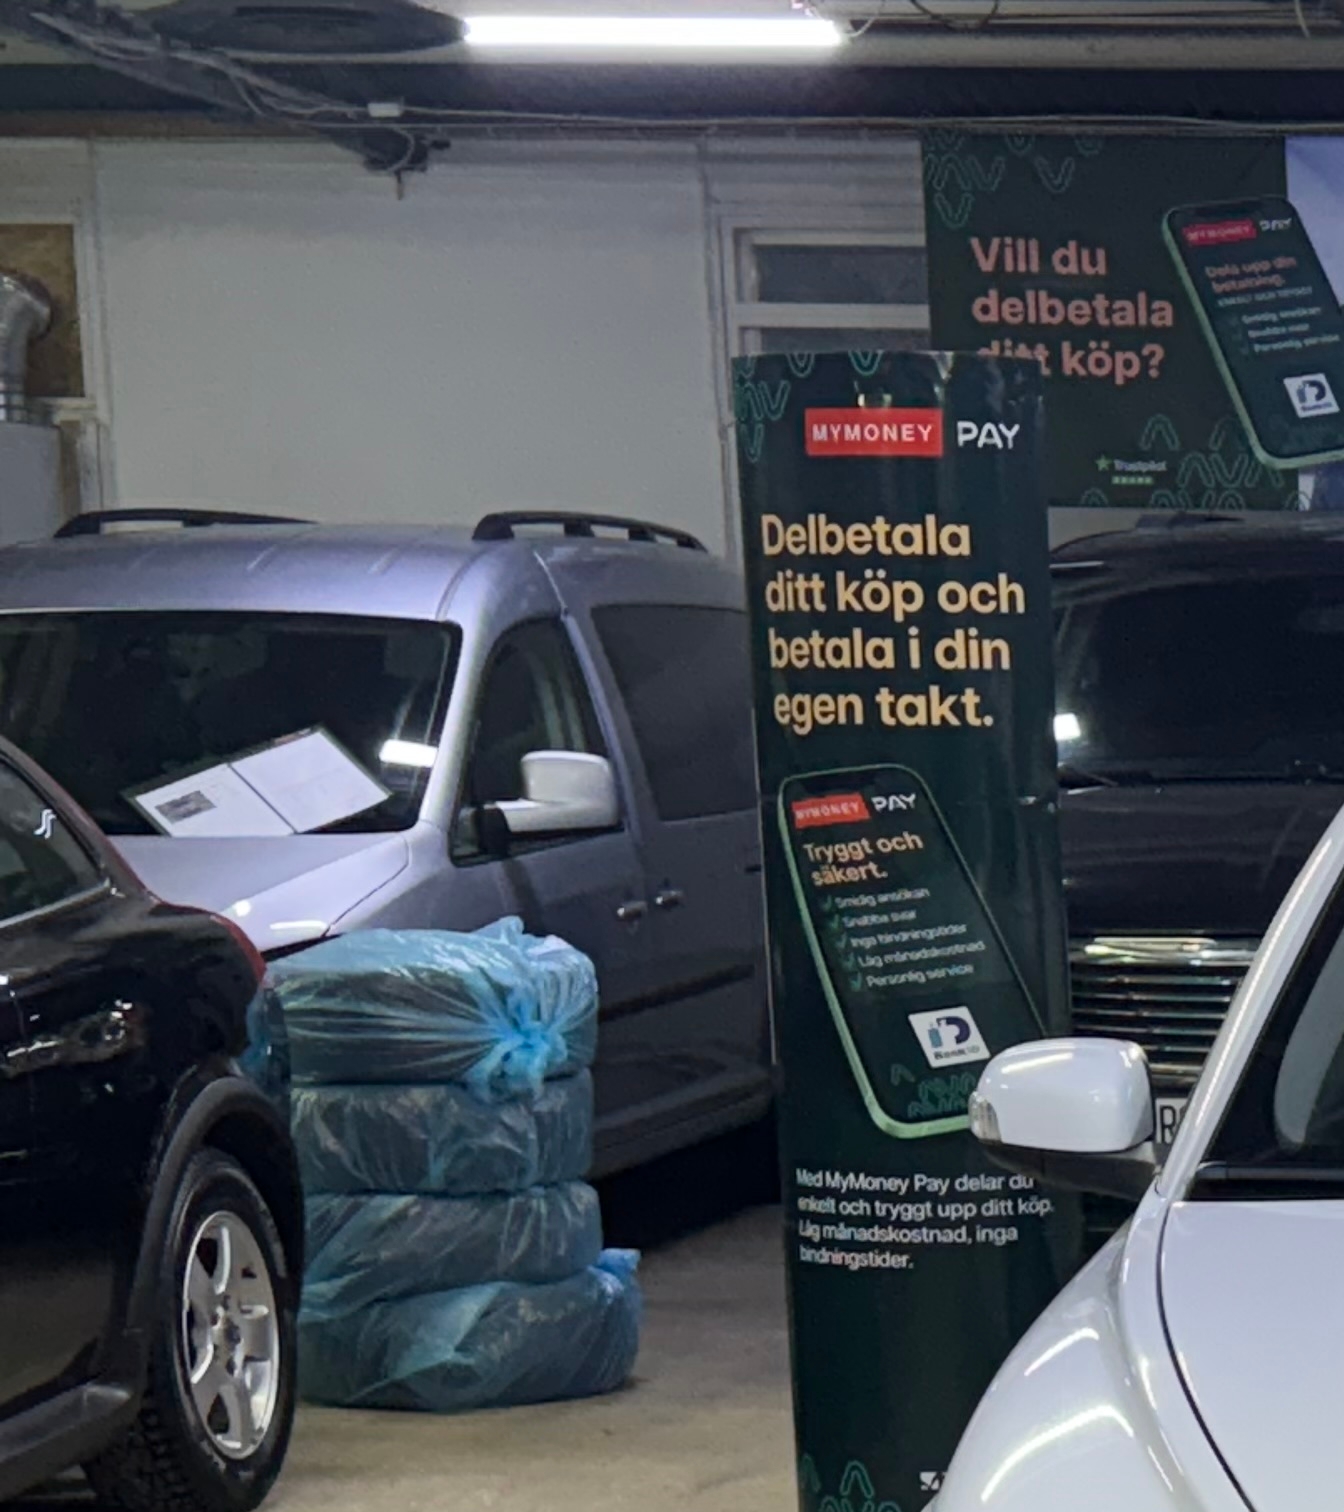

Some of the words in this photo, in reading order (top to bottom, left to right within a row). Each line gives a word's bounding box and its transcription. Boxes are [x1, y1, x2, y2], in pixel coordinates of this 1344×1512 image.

[971, 237, 1039, 273] Vill
[1052, 240, 1107, 275] du
[971, 289, 1174, 327] delbetala
[1061, 340, 1165, 385] köp?
[812, 423, 933, 443] MYMONEY
[957, 421, 1020, 449] PAY
[761, 514, 971, 556] Delbetala
[765, 569, 827, 611] ditt
[836, 569, 924, 623] köp
[937, 573, 1025, 614] och
[769, 627, 895, 669] betala
[908, 626, 921, 669] i
[935, 627, 1010, 670] din
[774, 693, 864, 735] egen
[876, 686, 994, 726] takt.
[871, 793, 916, 811] PAY
[803, 838, 873, 863] Tryggt
[876, 831, 924, 853] och
[811, 861, 889, 886] säkert.
[796, 1167, 823, 1188] Med
[825, 1170, 909, 1195] MyMoney
[913, 1173, 950, 1196] Pay
[954, 1173, 1004, 1191] delar
[1008, 1173, 1034, 1190] du
[839, 1199, 872, 1216] och
[874, 1200, 932, 1222] tryggt
[937, 1202, 977, 1221] upp
[980, 1199, 1014, 1217] ditt
[1017, 1195, 1055, 1217] köp.
[822, 1222, 972, 1245] månadskostnad,
[975, 1224, 1018, 1246] inga
[799, 1244, 914, 1271] bindningstider.
